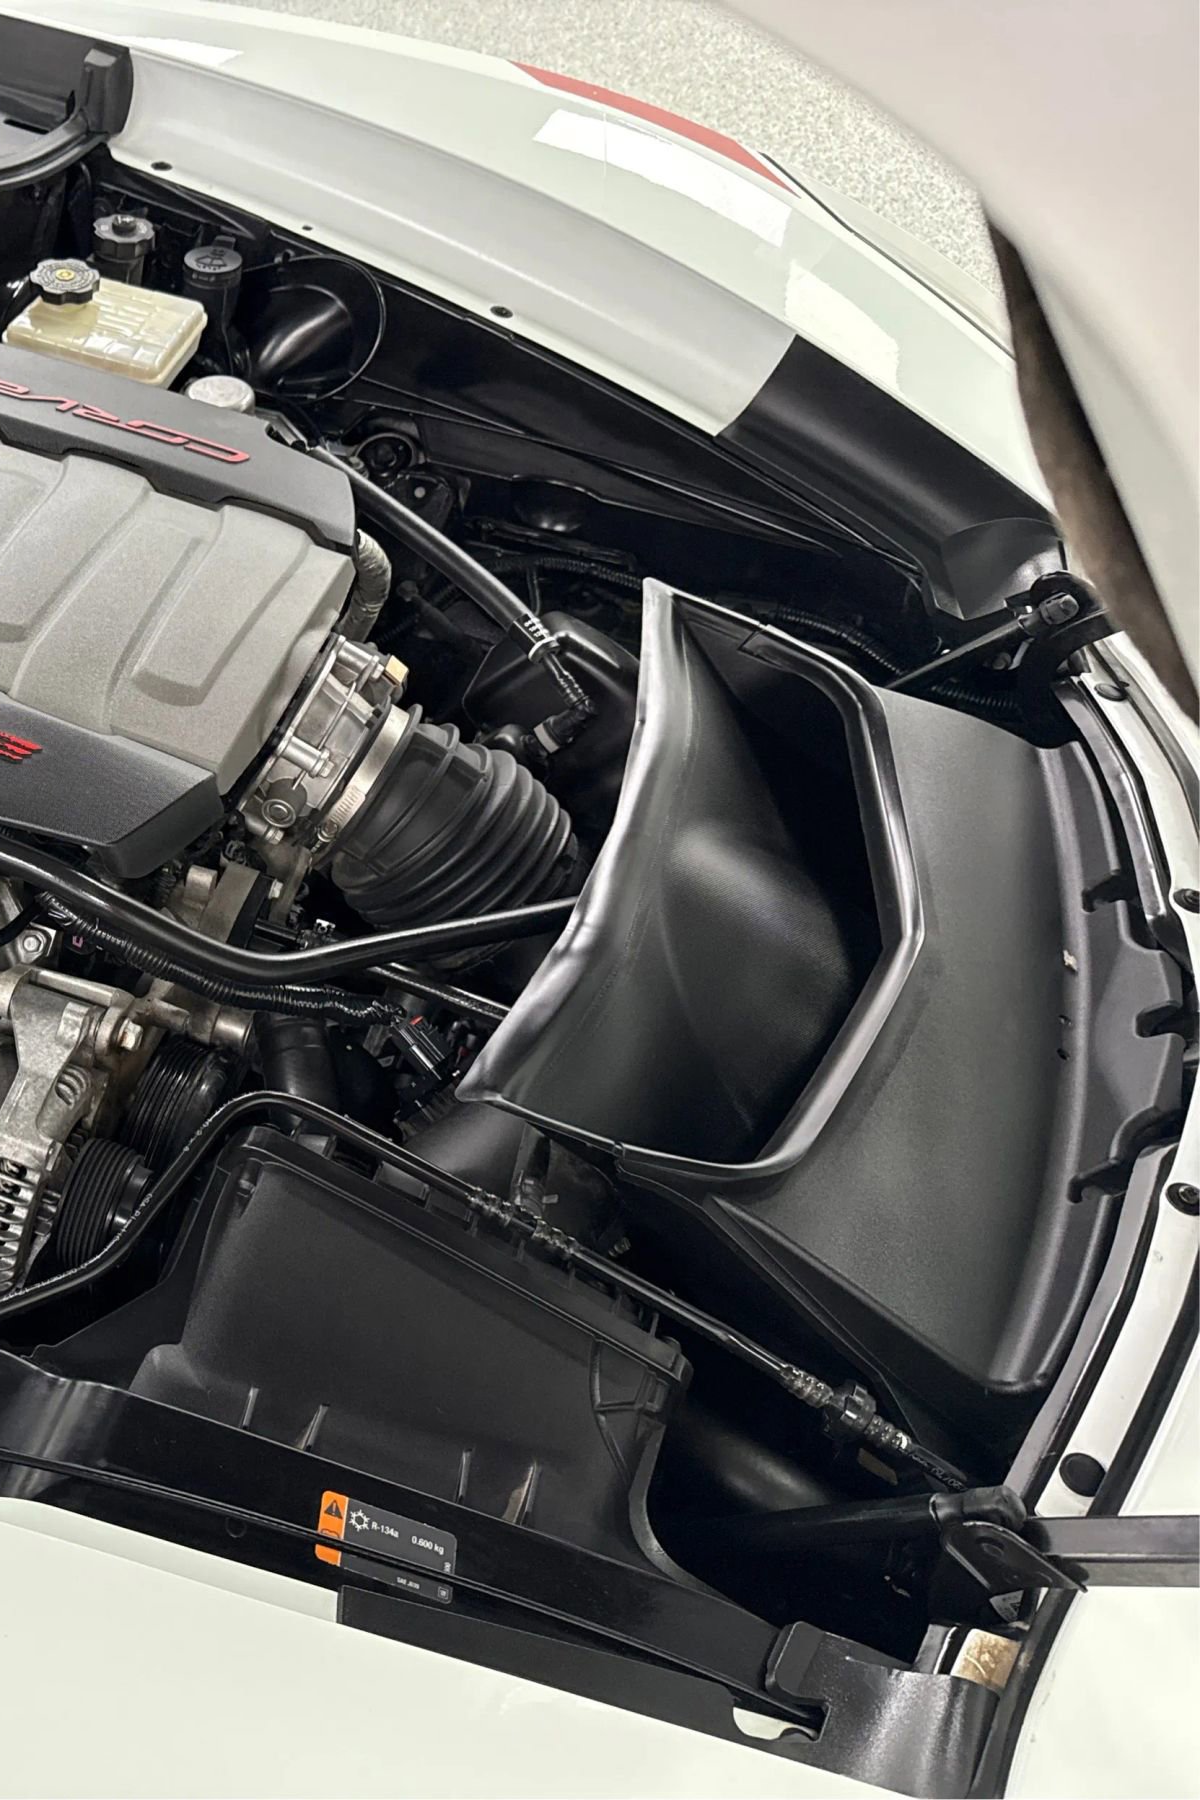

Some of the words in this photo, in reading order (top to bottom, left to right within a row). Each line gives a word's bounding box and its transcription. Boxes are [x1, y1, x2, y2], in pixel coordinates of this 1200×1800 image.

[371, 1521, 399, 1538] R-134a
[411, 1535, 434, 1552] 0.600
[433, 1543, 445, 1556] kg
